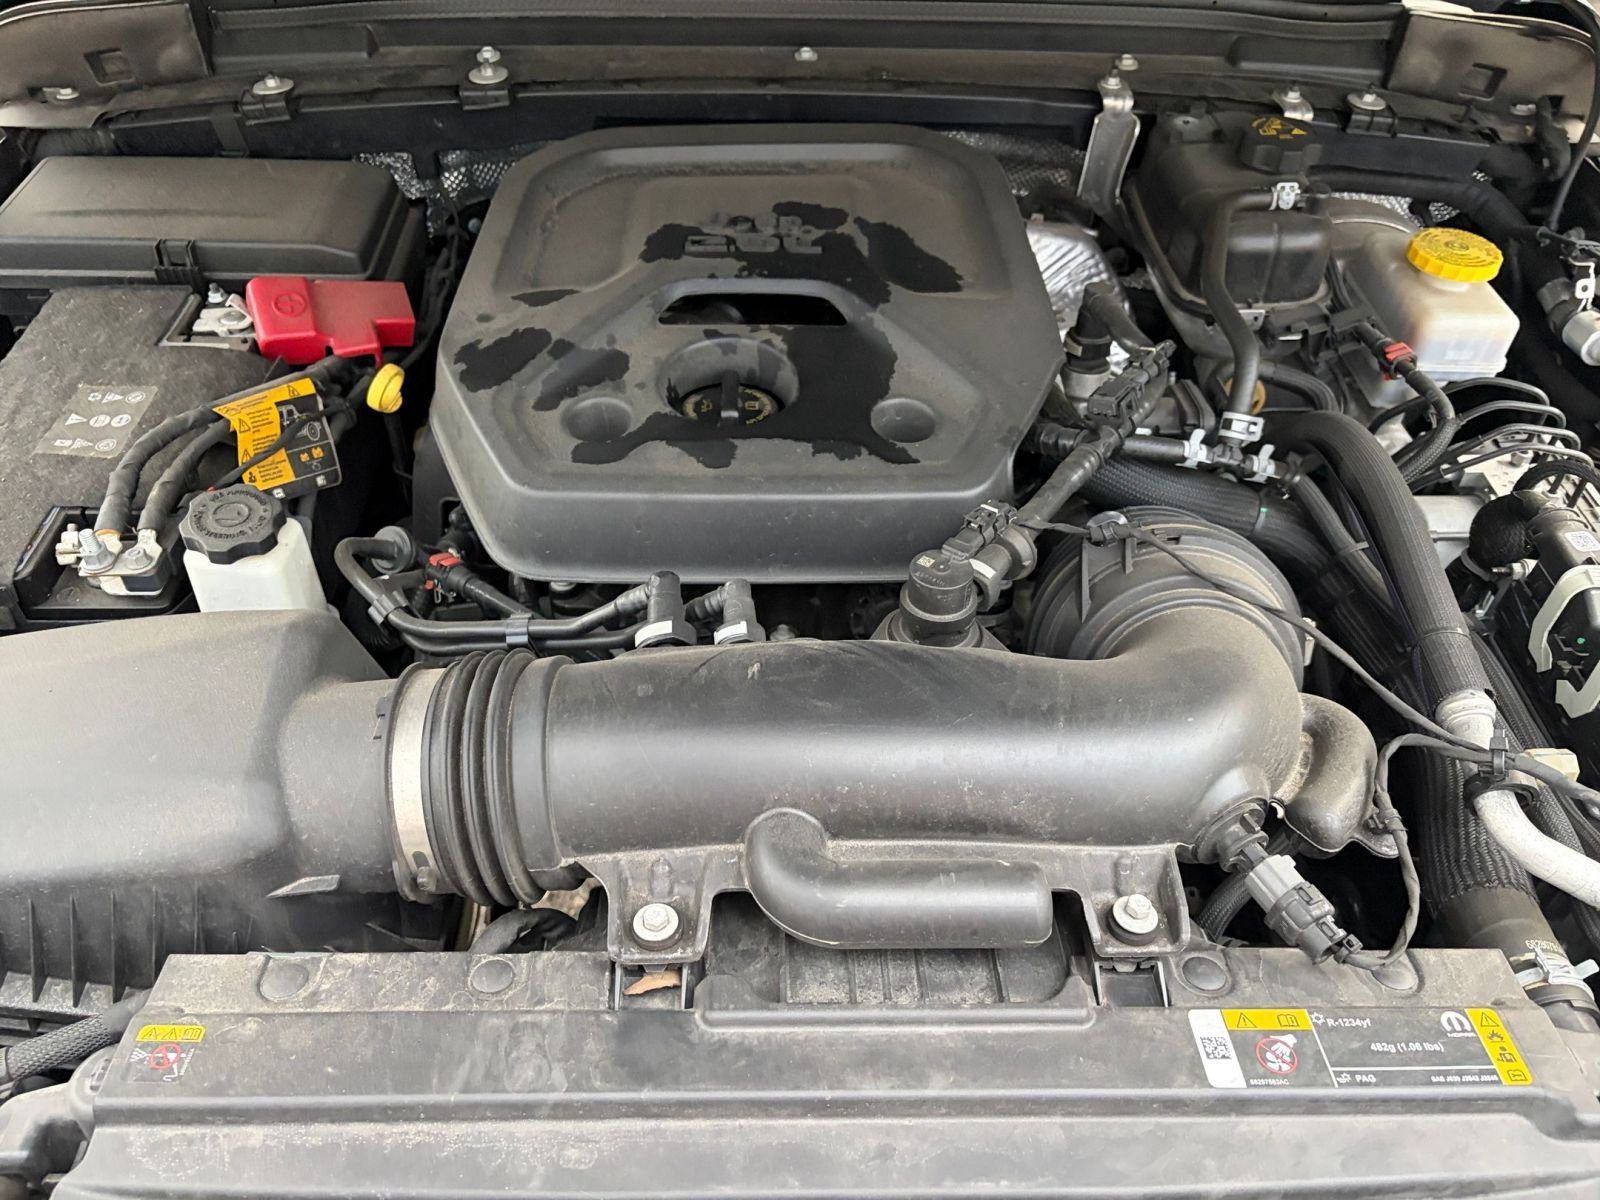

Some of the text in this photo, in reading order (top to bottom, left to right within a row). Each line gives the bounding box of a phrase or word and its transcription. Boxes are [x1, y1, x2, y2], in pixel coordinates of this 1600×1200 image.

[1370, 1042, 1396, 1054] 482g
[1423, 1041, 1445, 1053] lbs)
[1354, 1073, 1377, 1083] PAG
